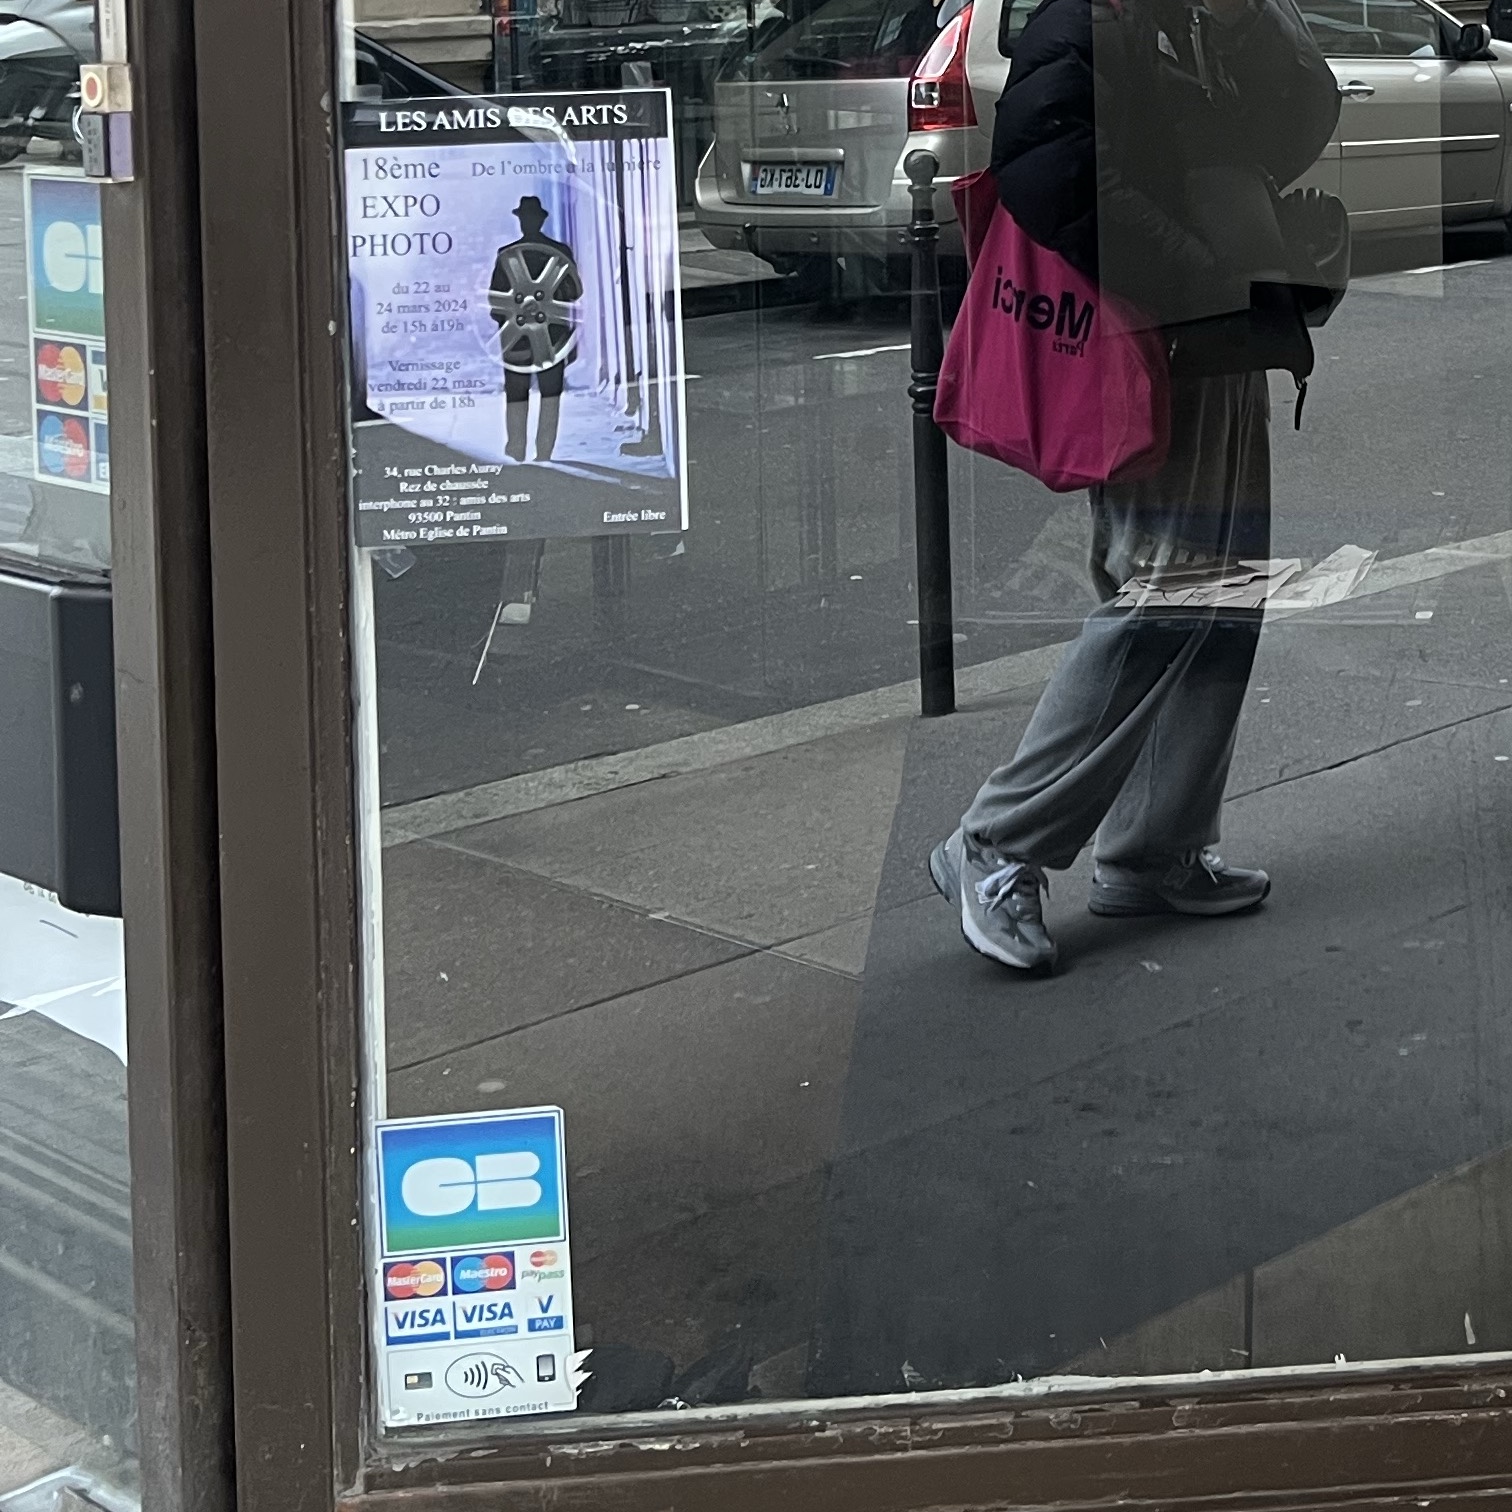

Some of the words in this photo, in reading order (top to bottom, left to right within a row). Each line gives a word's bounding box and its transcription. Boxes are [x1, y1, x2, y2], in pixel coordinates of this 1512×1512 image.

[379, 111, 427, 132] LES
[432, 108, 501, 131] AMIS
[561, 103, 628, 126] ARTS
[361, 156, 441, 181] 18ème
[472, 162, 495, 177] De
[581, 157, 594, 173] la
[361, 193, 441, 219] EXPO
[351, 230, 453, 258] PHOTO
[392, 282, 409, 295] du
[413, 281, 430, 294] 22
[434, 284, 450, 293] au
[376, 302, 393, 315] 24
[397, 304, 431, 314] mars
[434, 299, 468, 313] 2024
[381, 322, 398, 334] de
[403, 320, 427, 333] 15h
[388, 359, 462, 373] Vernissage
[368, 379, 427, 392] vendredi
[431, 377, 448, 391] 22
[452, 379, 486, 390] mars
[390, 399, 426, 414] partir
[429, 397, 447, 410] de
[451, 395, 476, 409] 18h
[436, 495, 450, 507] 32
[408, 511, 444, 524] 93500
[603, 510, 639, 523] Entrée
[641, 509, 666, 521] libre
[382, 527, 417, 540] Métro
[401, 1151, 542, 1217] CB
[387, 1273, 445, 1287] MasterCard
[459, 1267, 508, 1280] Maestro
[392, 1307, 447, 1330] VISA
[461, 1301, 514, 1324] VISA
[535, 1317, 557, 1330] PAY
[417, 1409, 471, 1422] Paiement
[474, 1406, 501, 1416] sans
[505, 1400, 549, 1413] contact
